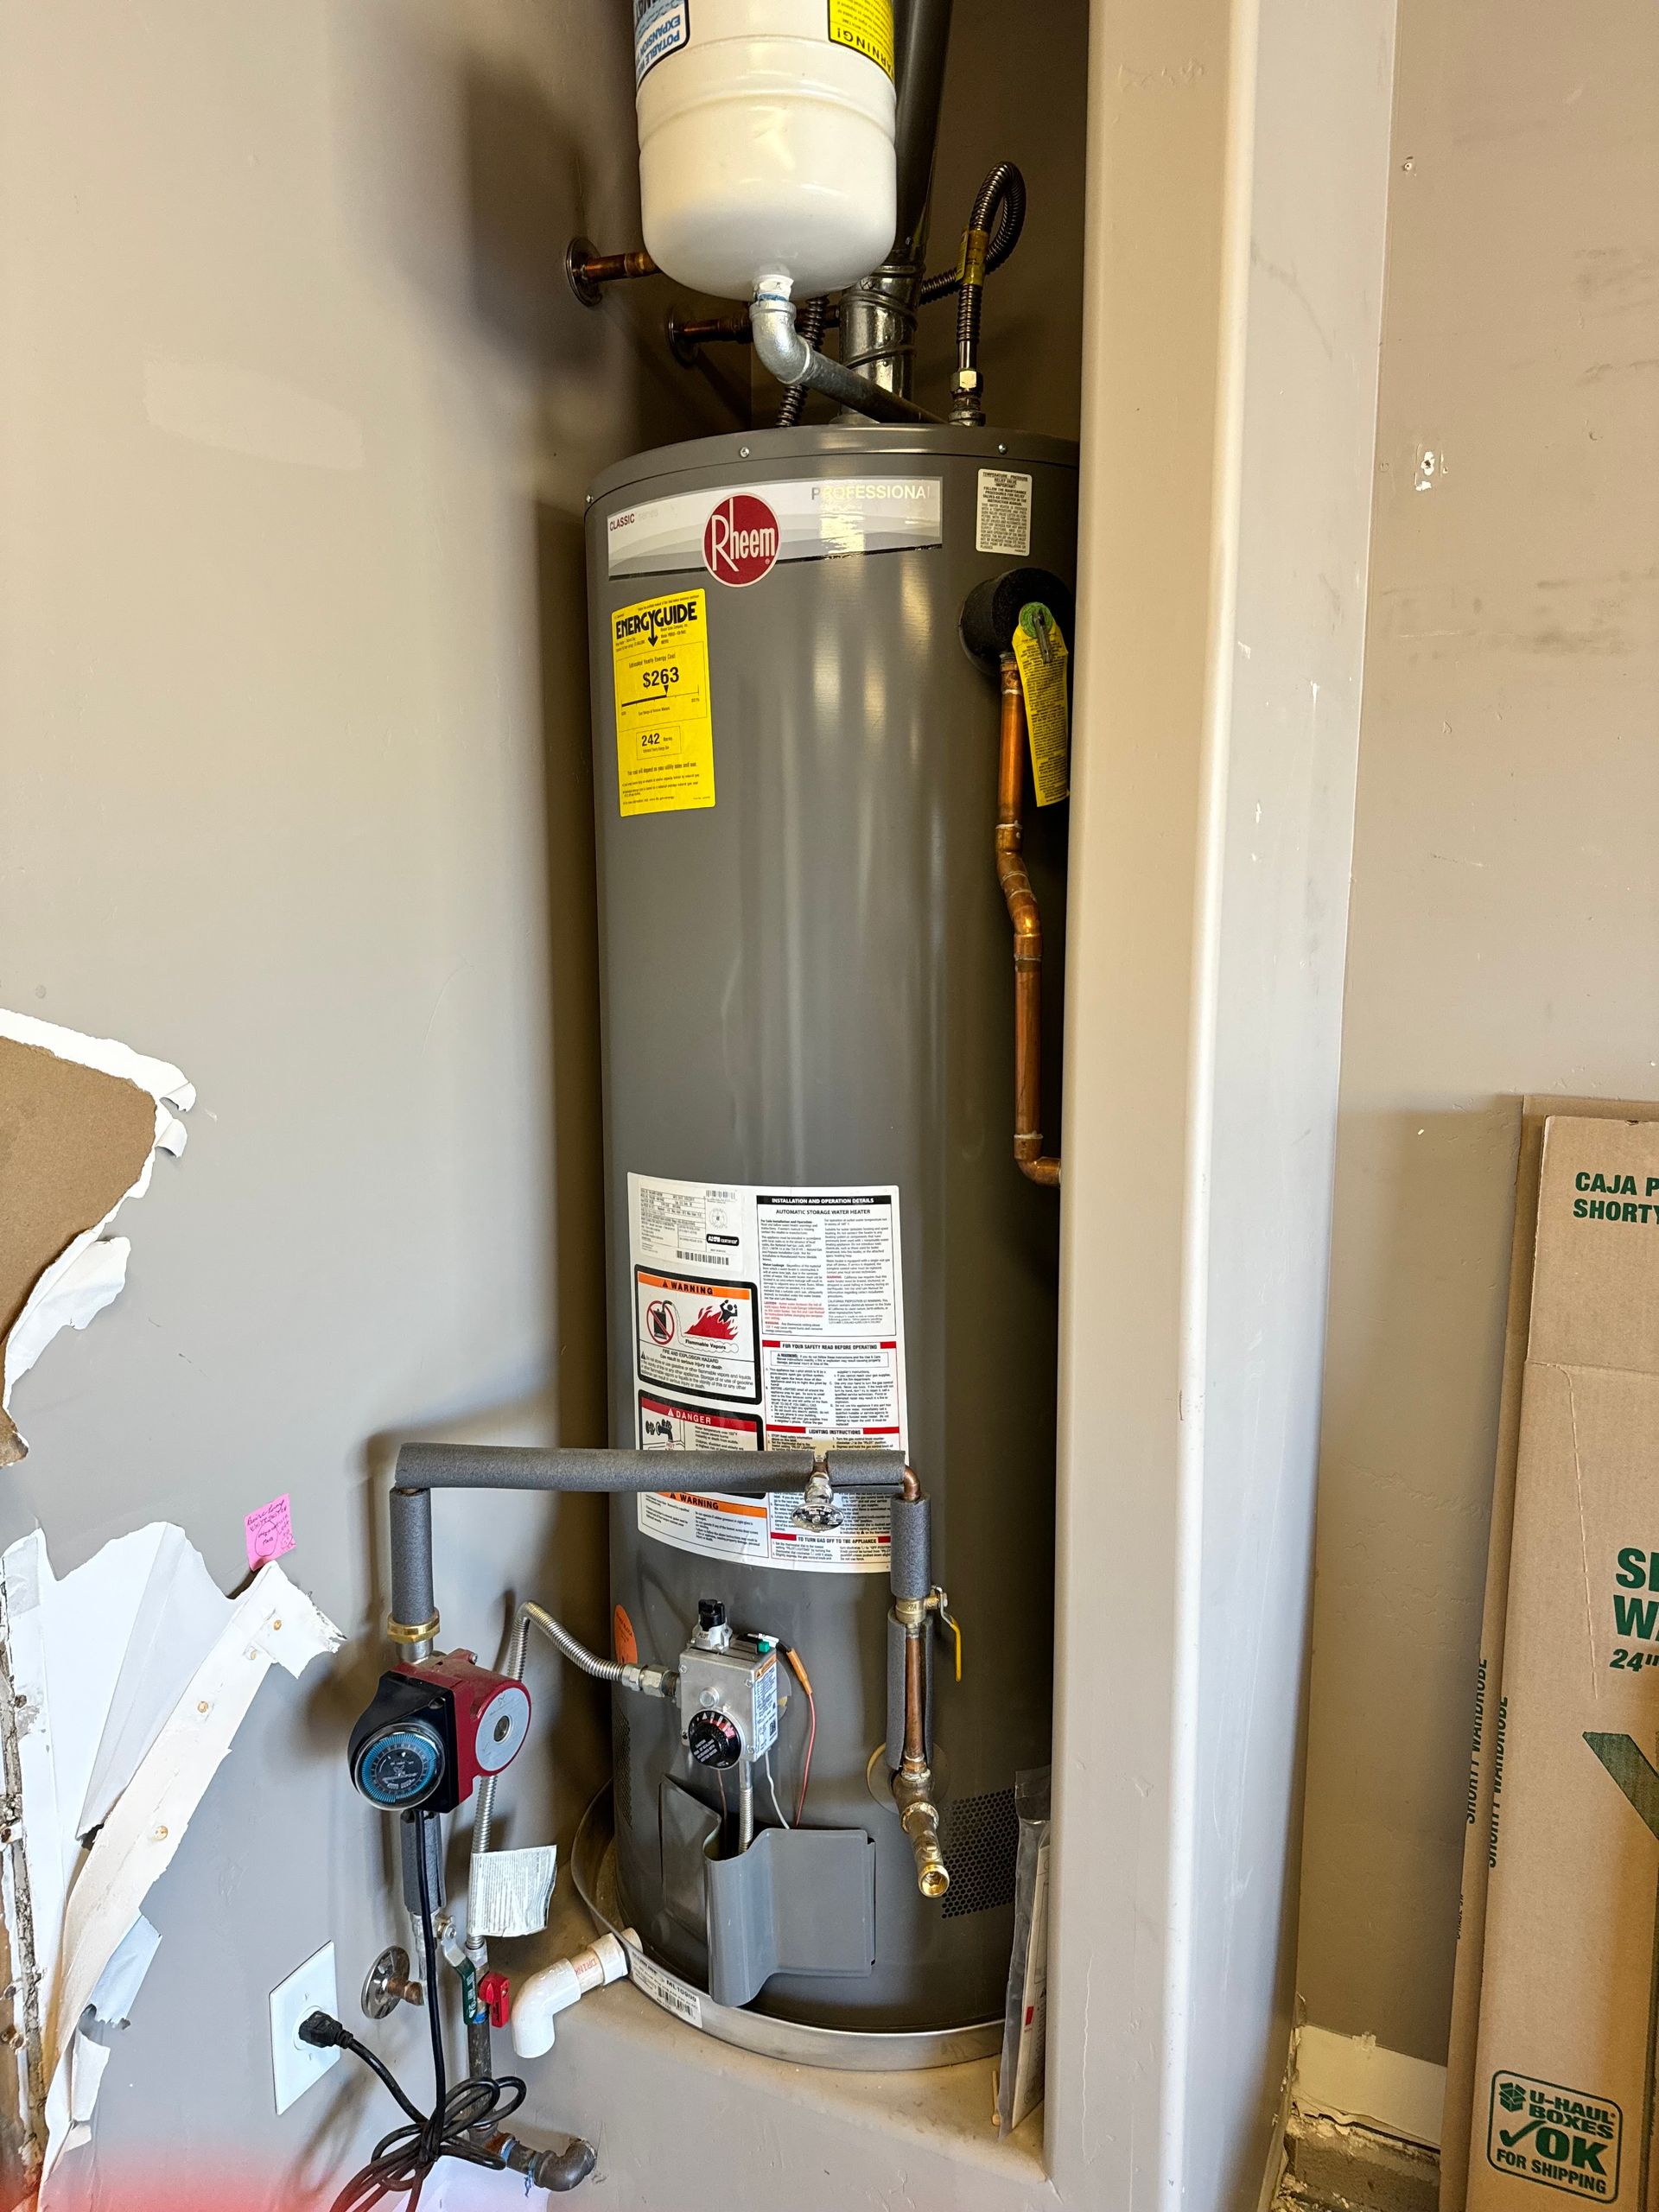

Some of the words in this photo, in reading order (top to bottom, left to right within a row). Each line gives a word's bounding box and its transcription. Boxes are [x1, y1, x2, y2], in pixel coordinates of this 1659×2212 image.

[640, 15, 680, 56] EXPANSION
[645, 29, 680, 67] POTABLE
[609, 513, 635, 531] CLASSIC
[711, 498, 775, 572] Rheem
[616, 601, 697, 643] ENERGYGUIDE
[643, 666, 679, 690] $263
[641, 733, 660, 747] 242
[1575, 1172, 1637, 1196] CAJA
[671, 1281, 713, 1295] WARNING
[679, 1352, 702, 1361] EXPLOSION
[685, 1339, 709, 1348] Flammable
[677, 1410, 711, 1425] DANGER
[680, 1494, 719, 1510] WARNING
[1613, 1594, 1659, 1642] W
[1529, 2089, 1614, 2126] U-HAUL
[1529, 2104, 1614, 2139] BOXES
[1535, 2126, 1608, 2177] OK
[1497, 2148, 1527, 2170] FOR
[1531, 2159, 1606, 2195] SHIPPING
